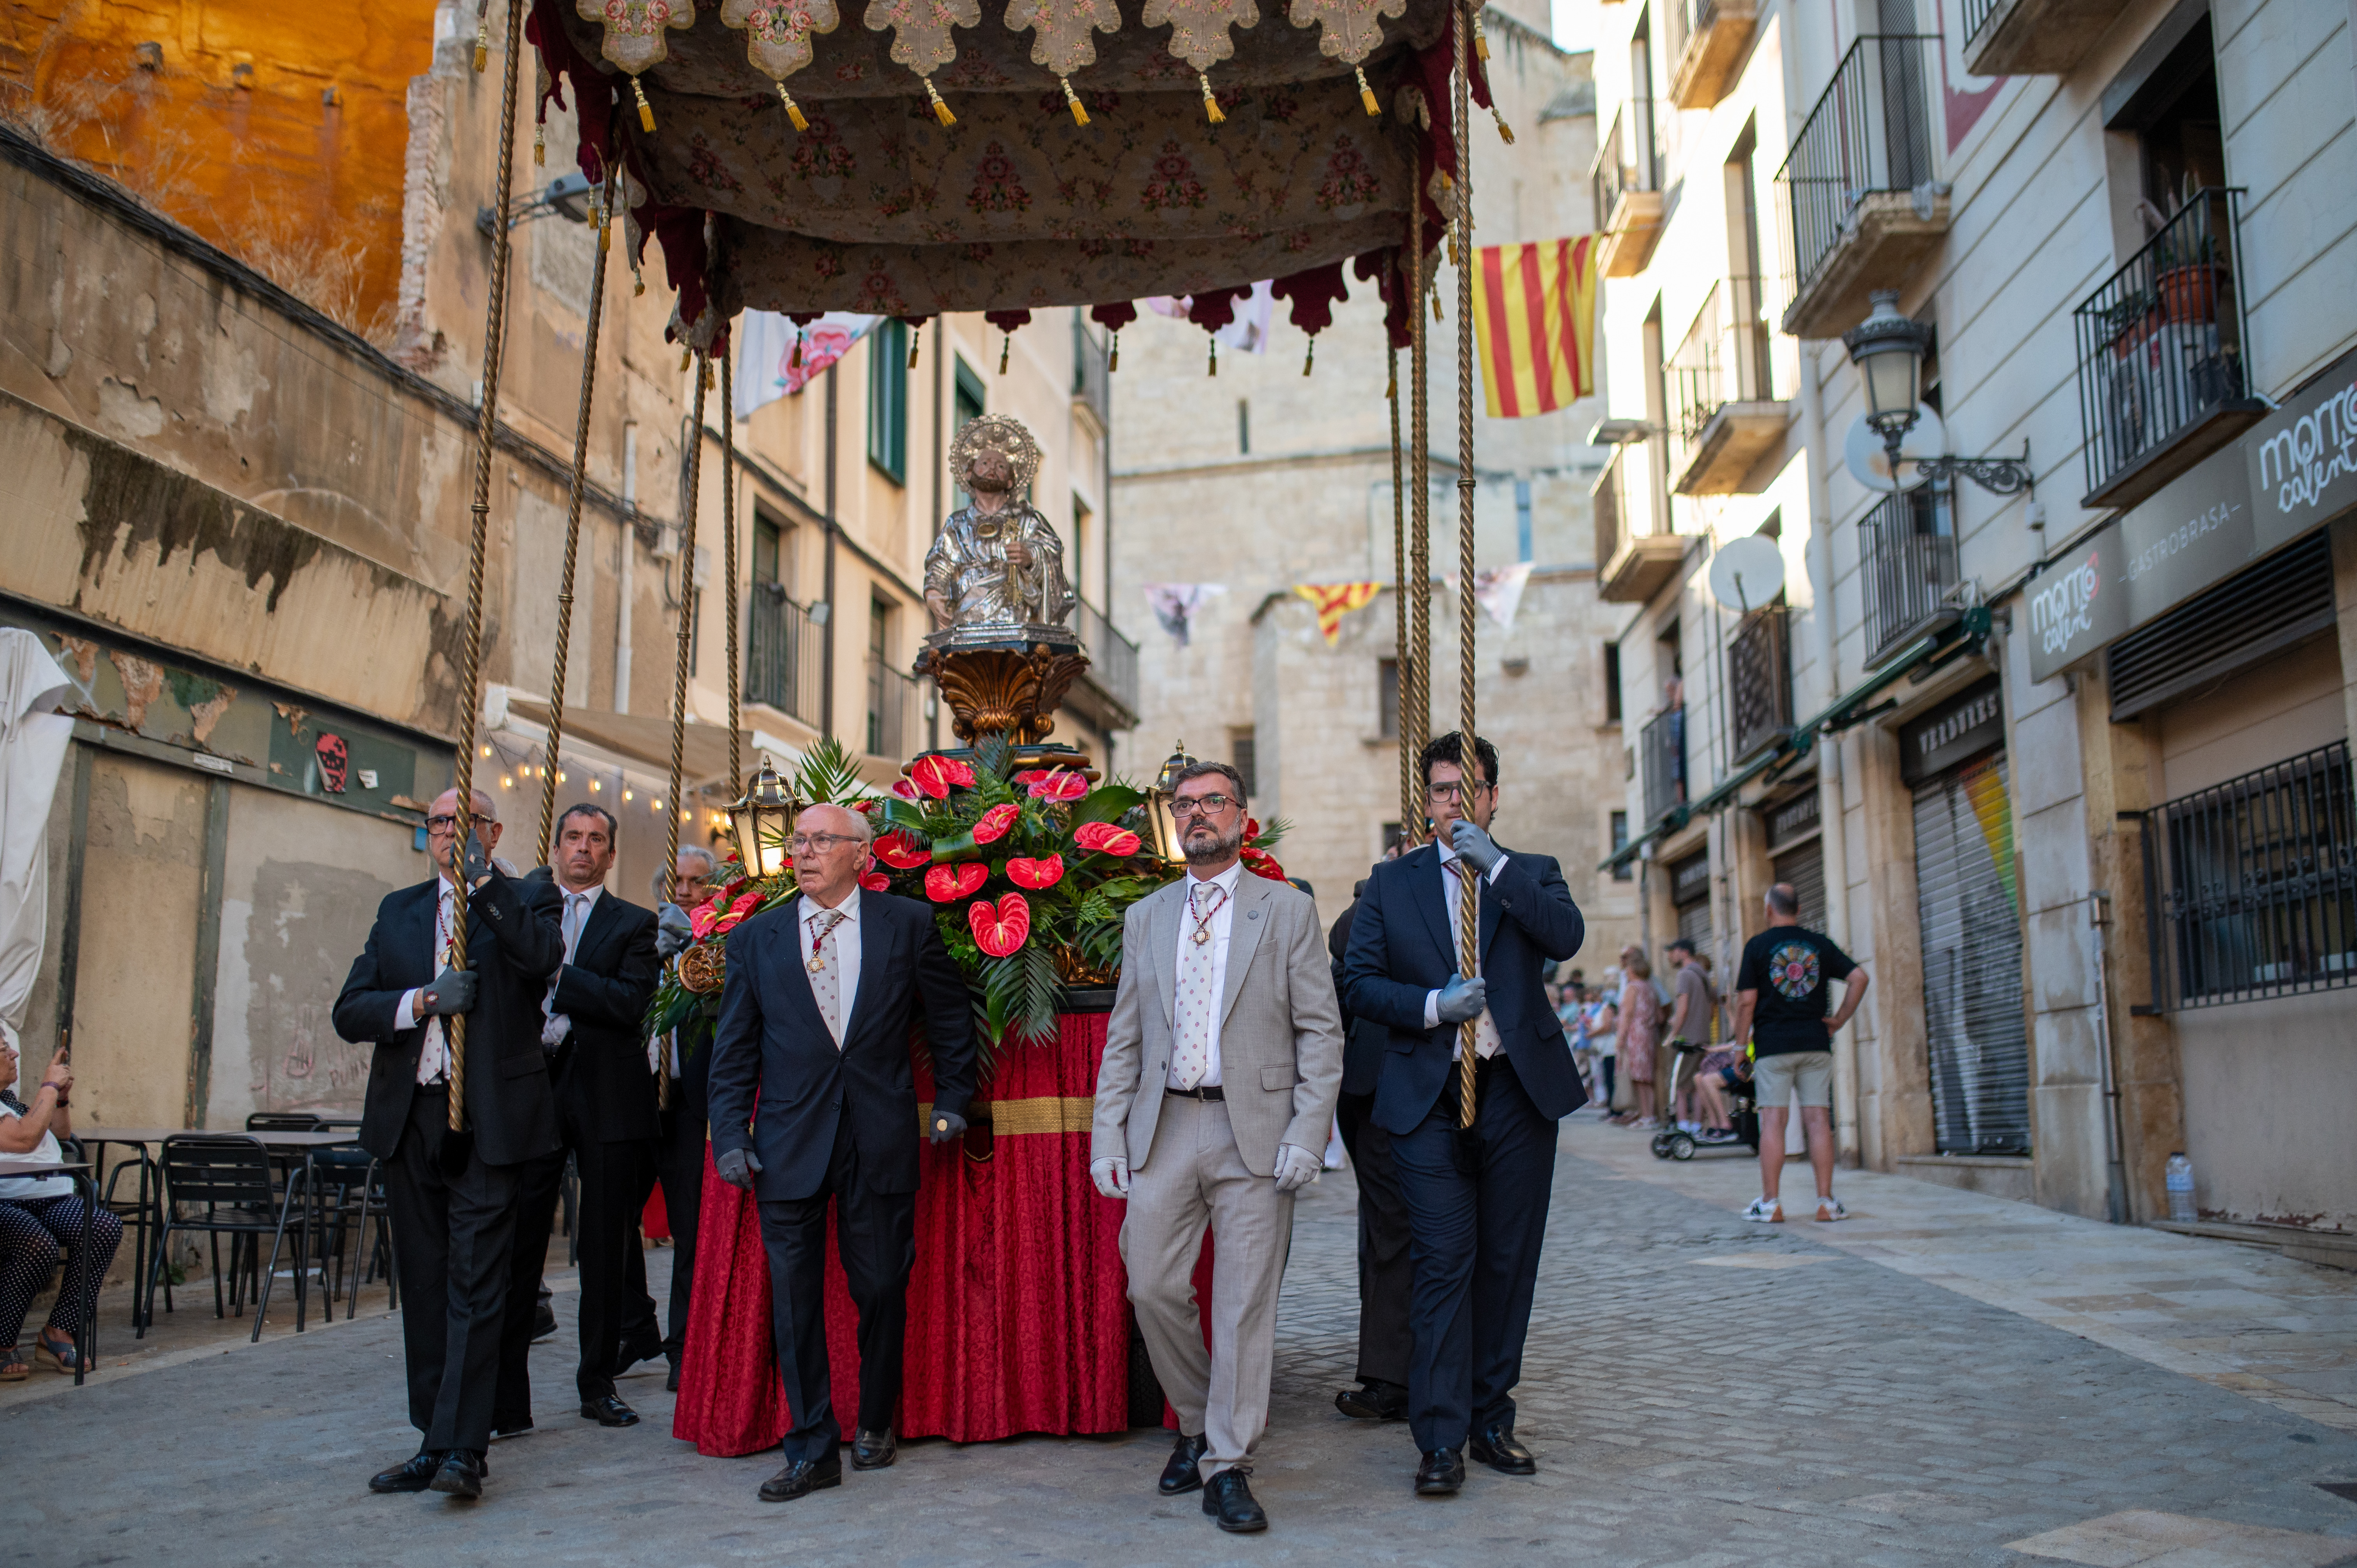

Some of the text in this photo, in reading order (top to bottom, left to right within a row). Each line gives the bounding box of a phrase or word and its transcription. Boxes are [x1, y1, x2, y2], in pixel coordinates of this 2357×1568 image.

[2127, 501, 2230, 582] GASTROBRASA
[2031, 552, 2100, 636] morro
[1918, 694, 1998, 756] VERDURES
